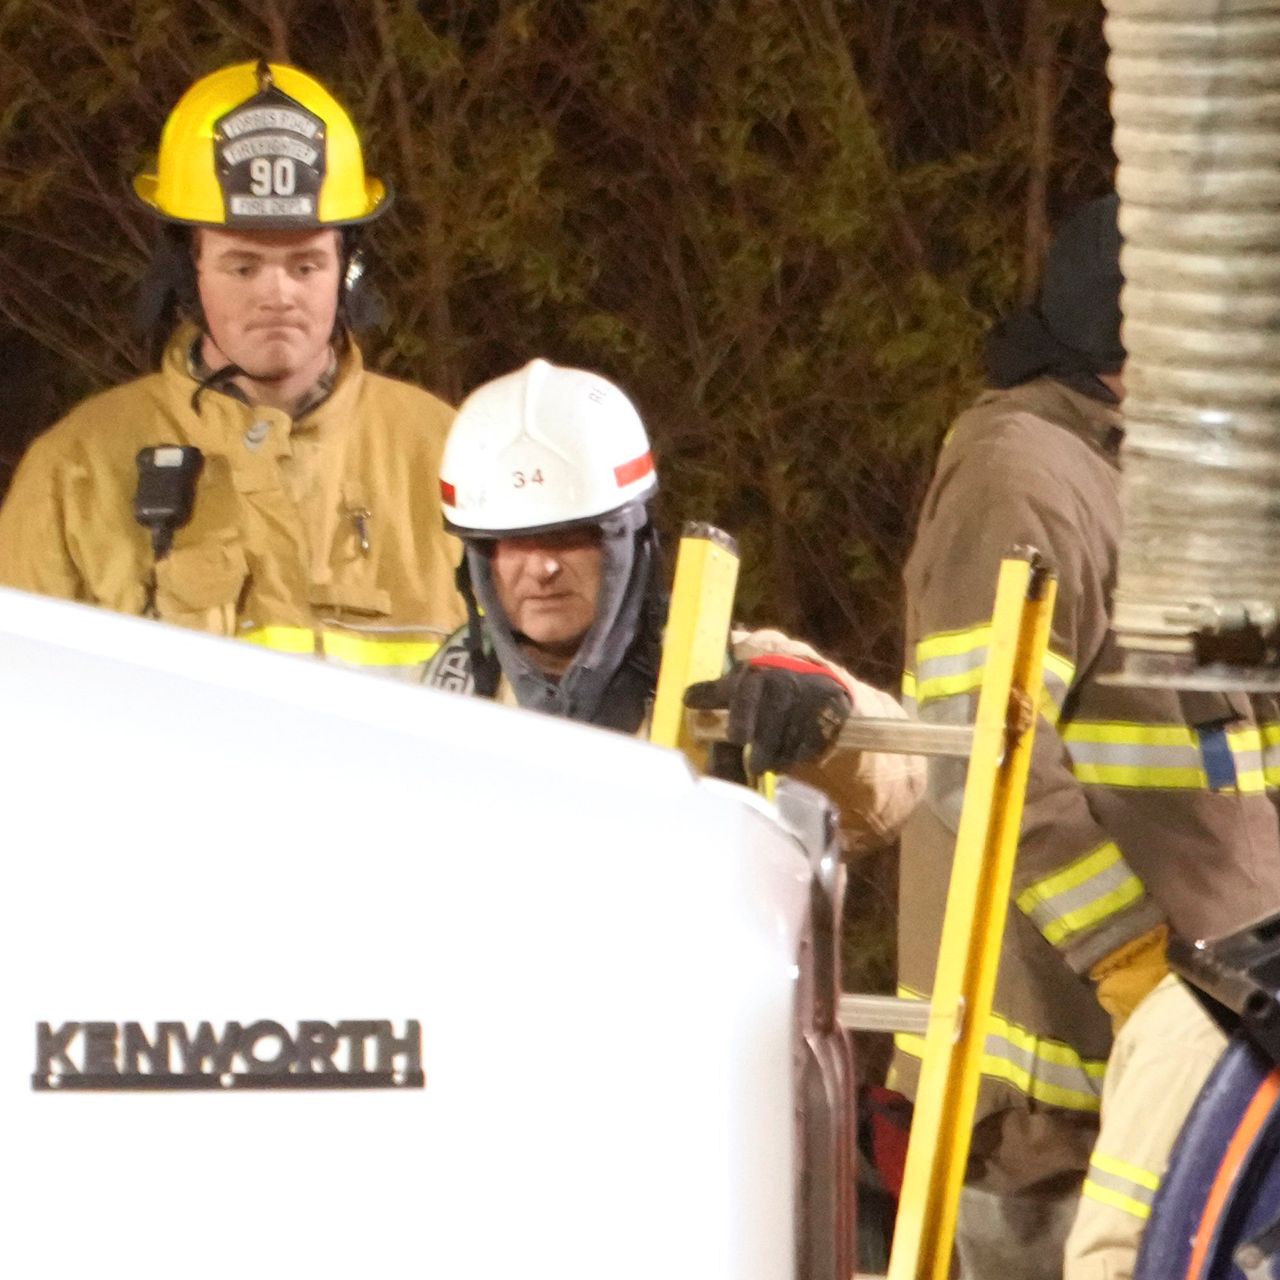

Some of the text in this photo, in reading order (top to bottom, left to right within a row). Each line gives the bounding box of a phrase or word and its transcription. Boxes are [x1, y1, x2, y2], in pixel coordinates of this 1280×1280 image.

[250, 158, 295, 196] 90
[512, 468, 545, 488] 34
[36, 1019, 422, 1074] KENWORTH
